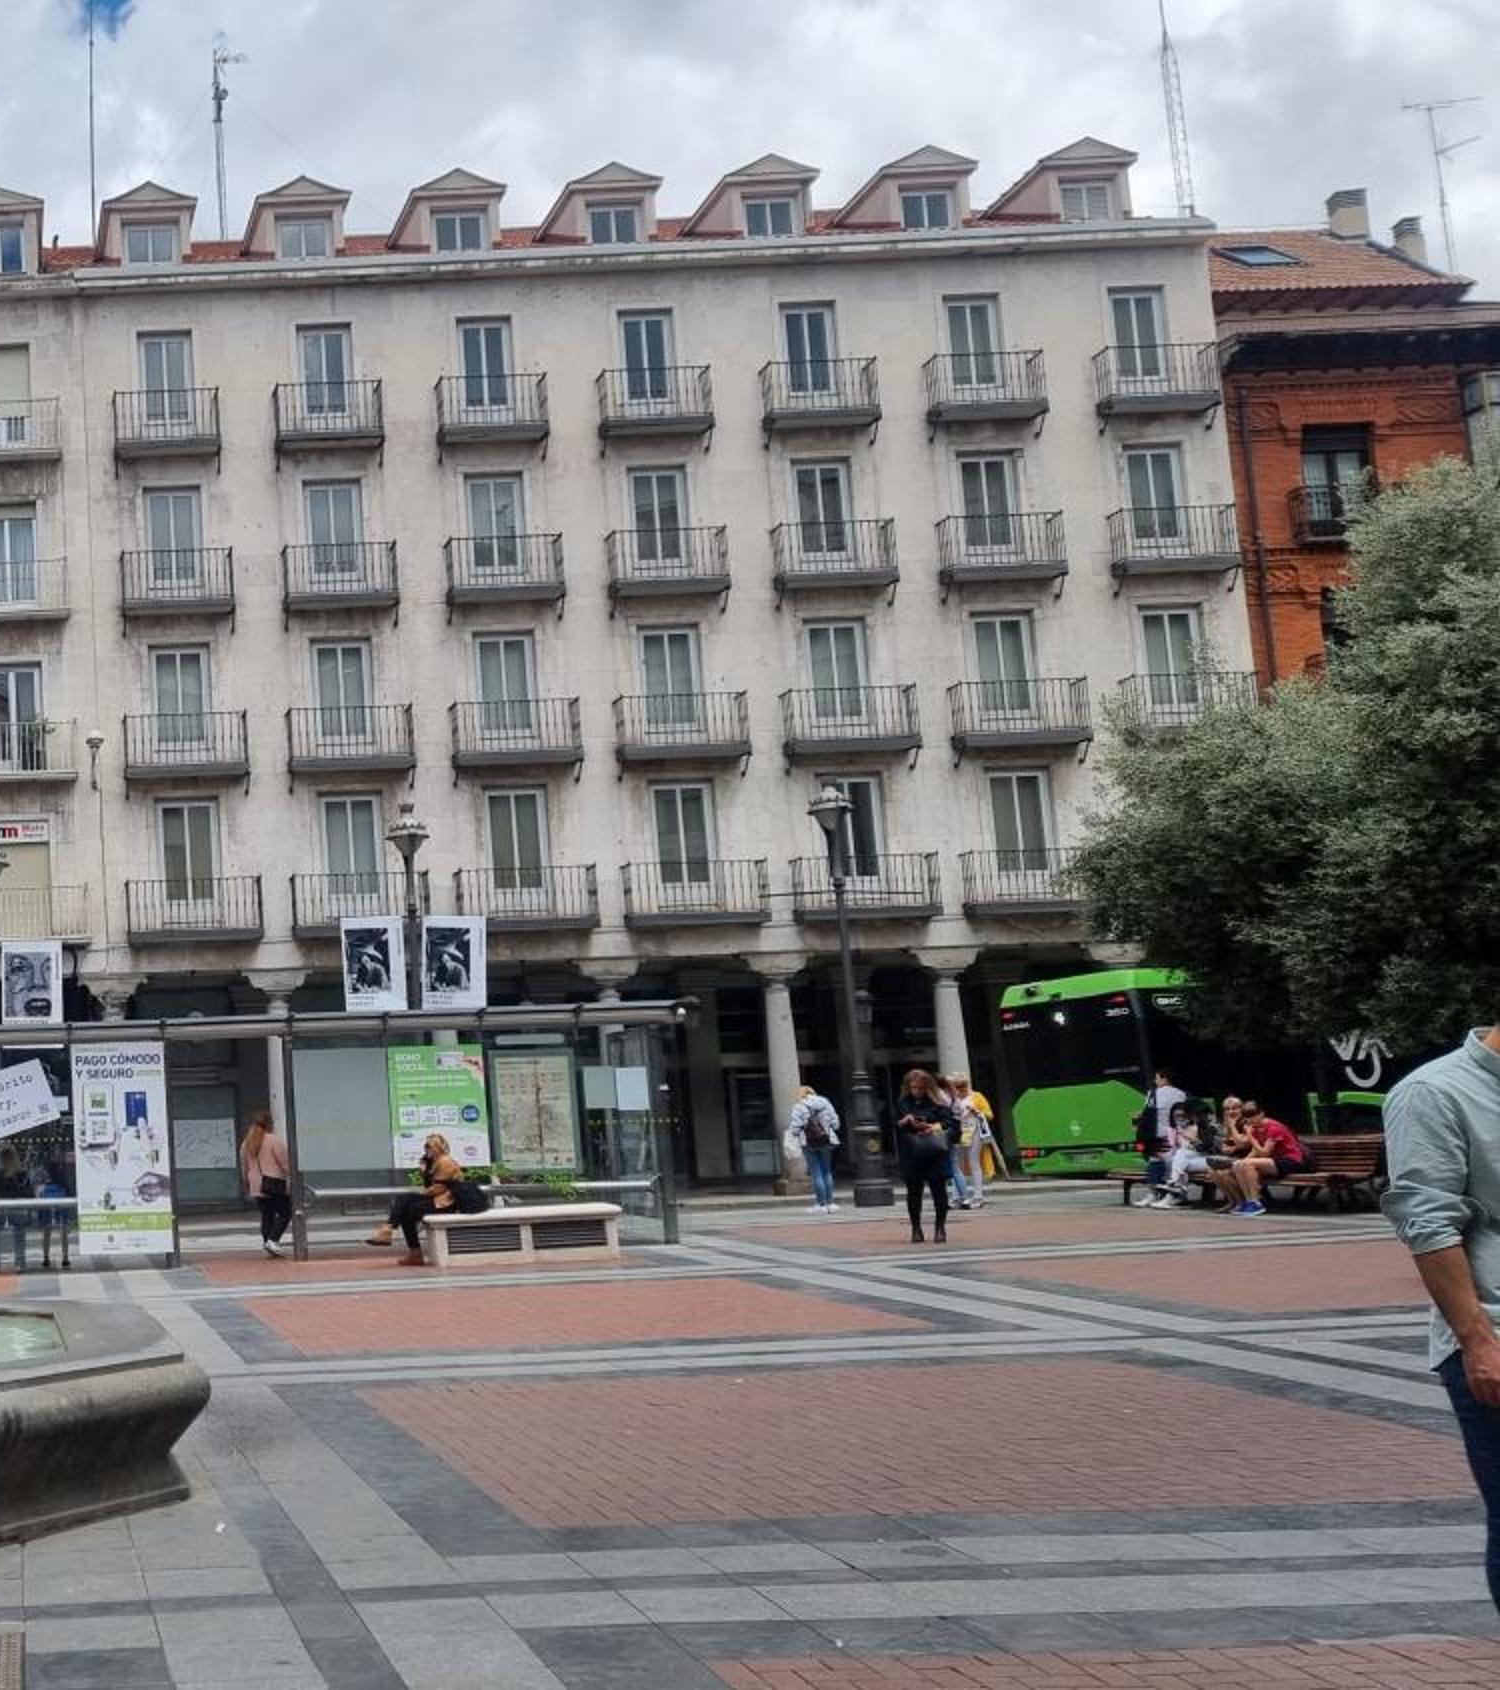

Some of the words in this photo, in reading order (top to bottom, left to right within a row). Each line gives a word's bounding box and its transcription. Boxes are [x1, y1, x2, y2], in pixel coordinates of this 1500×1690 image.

[76, 1055, 106, 1066] PAGO
[110, 1051, 160, 1065] CÓMODO
[76, 1069, 83, 1080] Y
[86, 1067, 134, 1079] SEGURO
